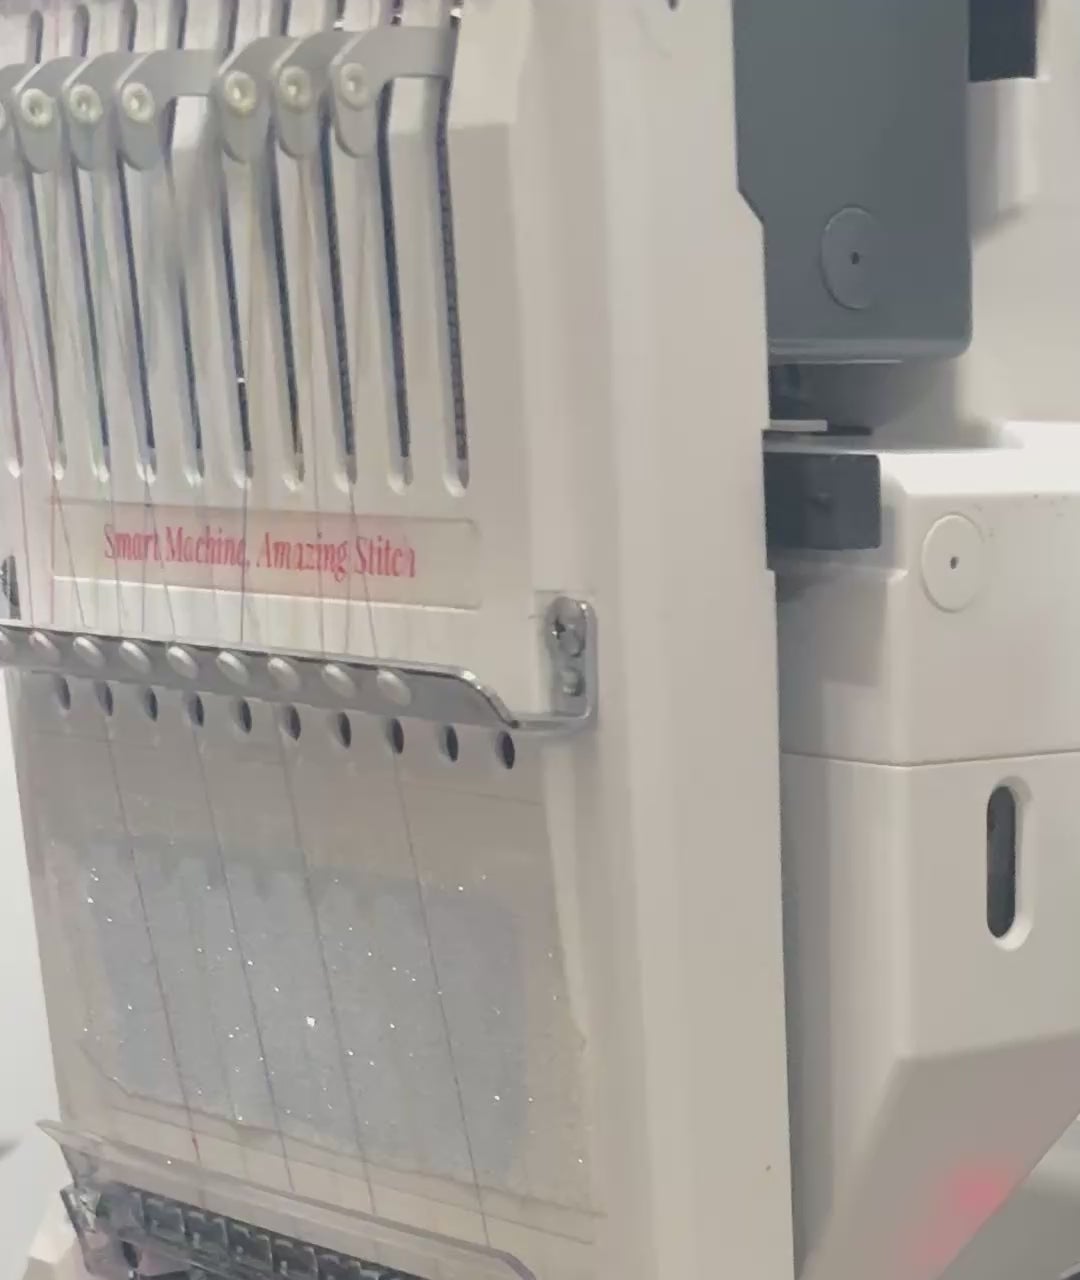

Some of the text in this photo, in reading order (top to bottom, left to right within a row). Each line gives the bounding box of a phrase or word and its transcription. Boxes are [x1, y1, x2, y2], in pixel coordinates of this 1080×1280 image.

[104, 524, 160, 561] Smart
[256, 532, 348, 583] Amazing
[354, 534, 416, 578] Stitch
